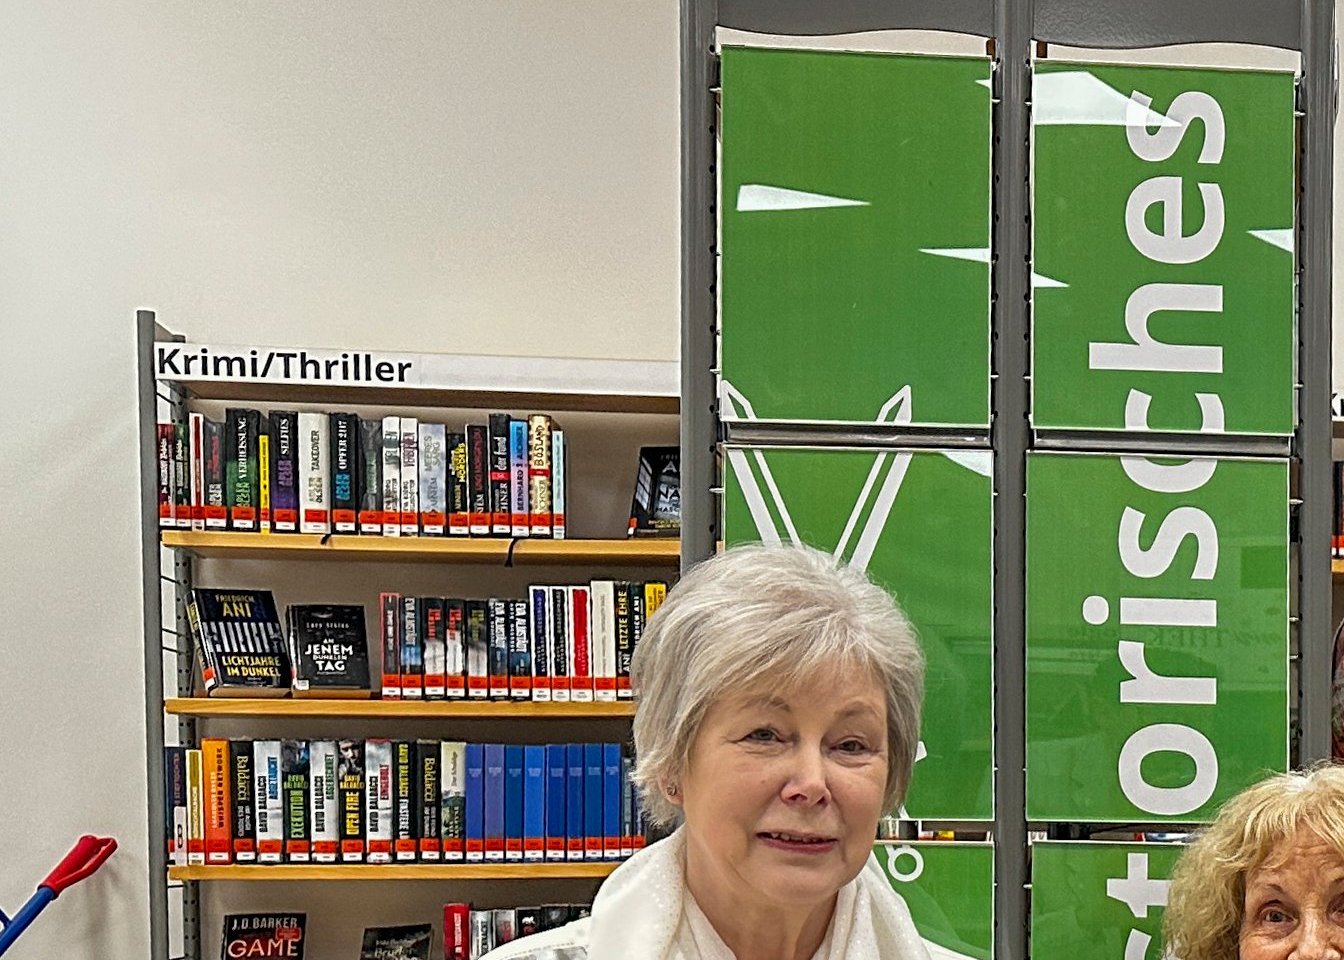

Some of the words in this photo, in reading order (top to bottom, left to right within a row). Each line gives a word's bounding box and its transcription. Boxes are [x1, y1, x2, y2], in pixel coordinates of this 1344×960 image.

[157, 346, 413, 383] Krimi/Thriller
[280, 418, 289, 455] SELFIES
[311, 430, 319, 472] TAKEOVER
[222, 602, 253, 618] ANI
[618, 590, 628, 616] EHRE
[618, 617, 629, 650] LETZTE
[221, 655, 282, 667] LICHTJAHRE
[304, 643, 354, 656] JENEM
[226, 666, 240, 677] IM
[241, 666, 282, 677] DUNKEL
[315, 660, 346, 672] TAG
[216, 748, 224, 788] NETWORK
[237, 755, 250, 801] Baldacci
[424, 757, 436, 802] Baldacci
[217, 790, 225, 828] WHISPER
[346, 791, 359, 811] FIRE
[346, 812, 360, 836] OPEN
[253, 917, 298, 930] BARKER
[228, 938, 298, 959] GAME
